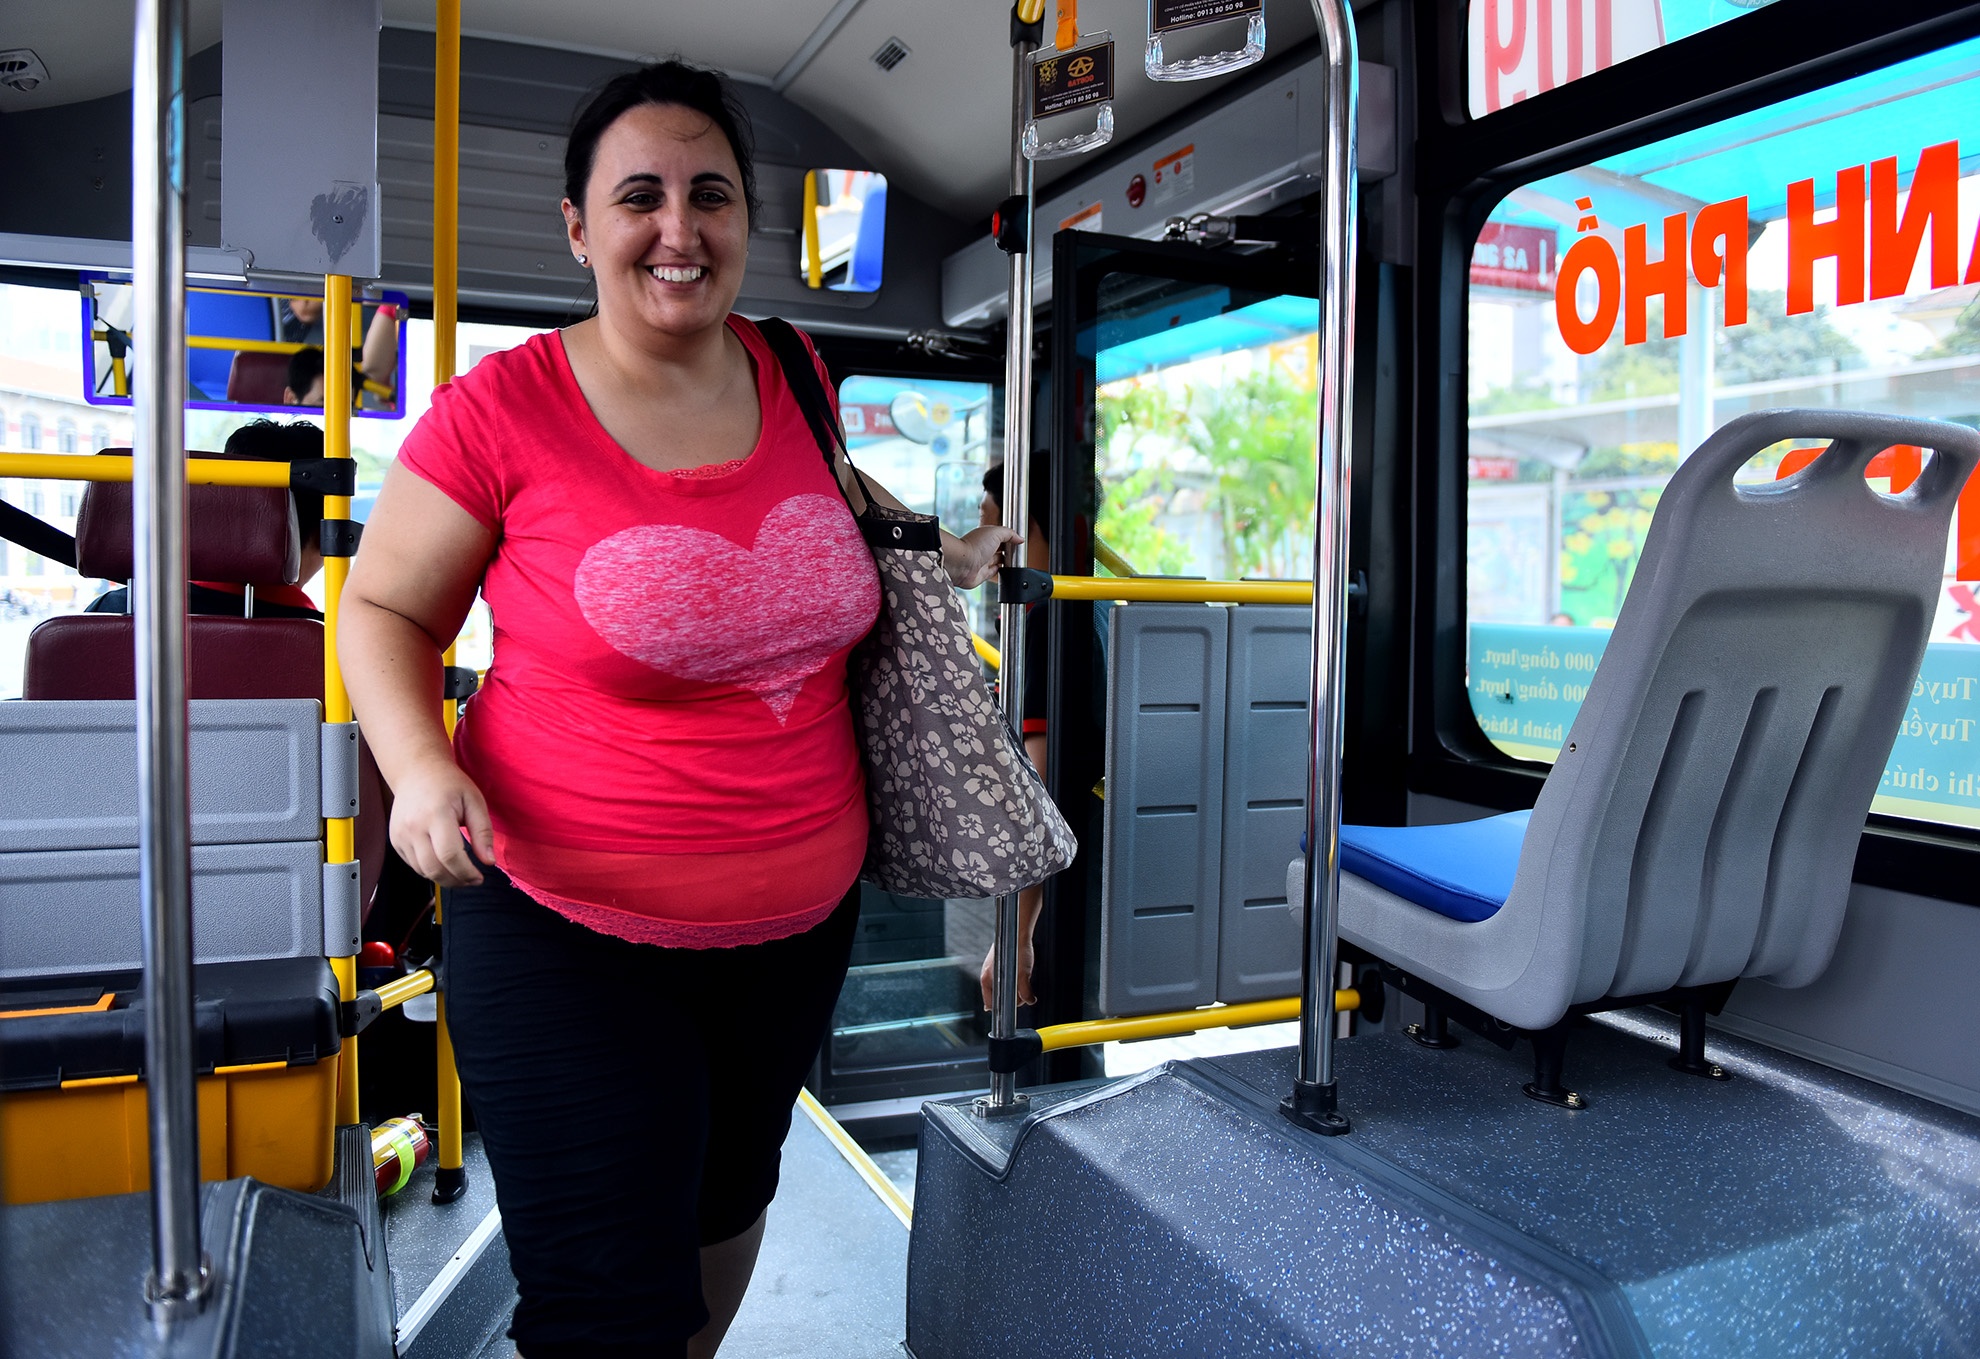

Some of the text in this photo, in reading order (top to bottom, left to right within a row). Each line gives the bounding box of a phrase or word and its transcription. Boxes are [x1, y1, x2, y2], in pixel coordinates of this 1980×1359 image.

[1170, 13, 1195, 23] Hotline:
[1197, 9, 1213, 17] 0913
[1225, 3, 1233, 11] 50
[1044, 102, 1063, 111] Hotline:
[1064, 98, 1077, 106] 0913
[1472, 242, 1529, 272] NG SA
